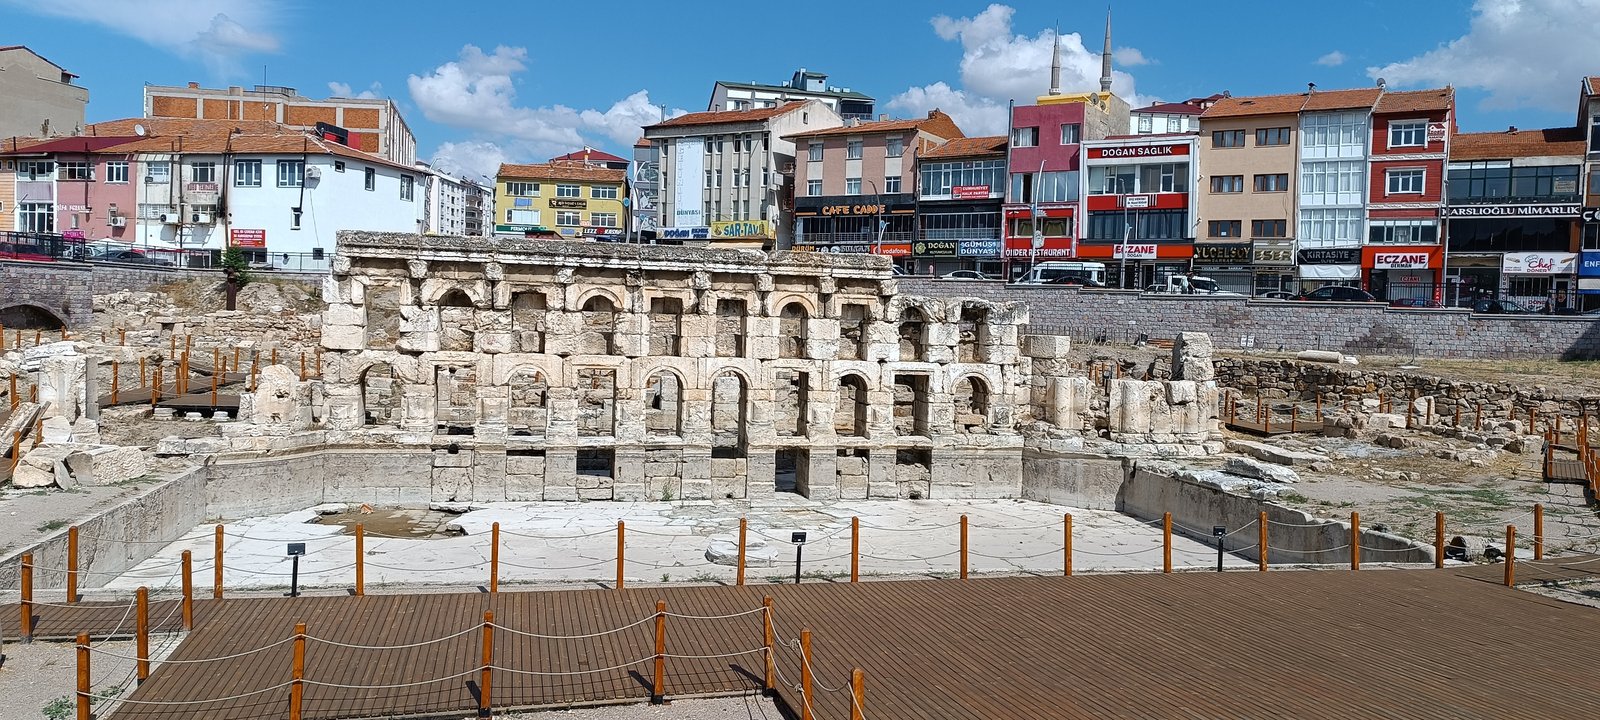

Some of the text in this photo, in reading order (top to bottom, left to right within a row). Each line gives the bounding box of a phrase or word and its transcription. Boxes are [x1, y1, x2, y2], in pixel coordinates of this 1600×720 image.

[821, 204, 886, 215] CAFE CADDE
[1442, 205, 1579, 216] KARSLIOĞLU MİMARLIK
[723, 222, 758, 237] SAR-TAV
[928, 241, 954, 249] DOĞAN
[1115, 246, 1154, 254] ECZANE
[1028, 248, 1070, 257] RESTAURANT
[1376, 255, 1426, 264] ECZANE
[1528, 258, 1555, 272] Chef
